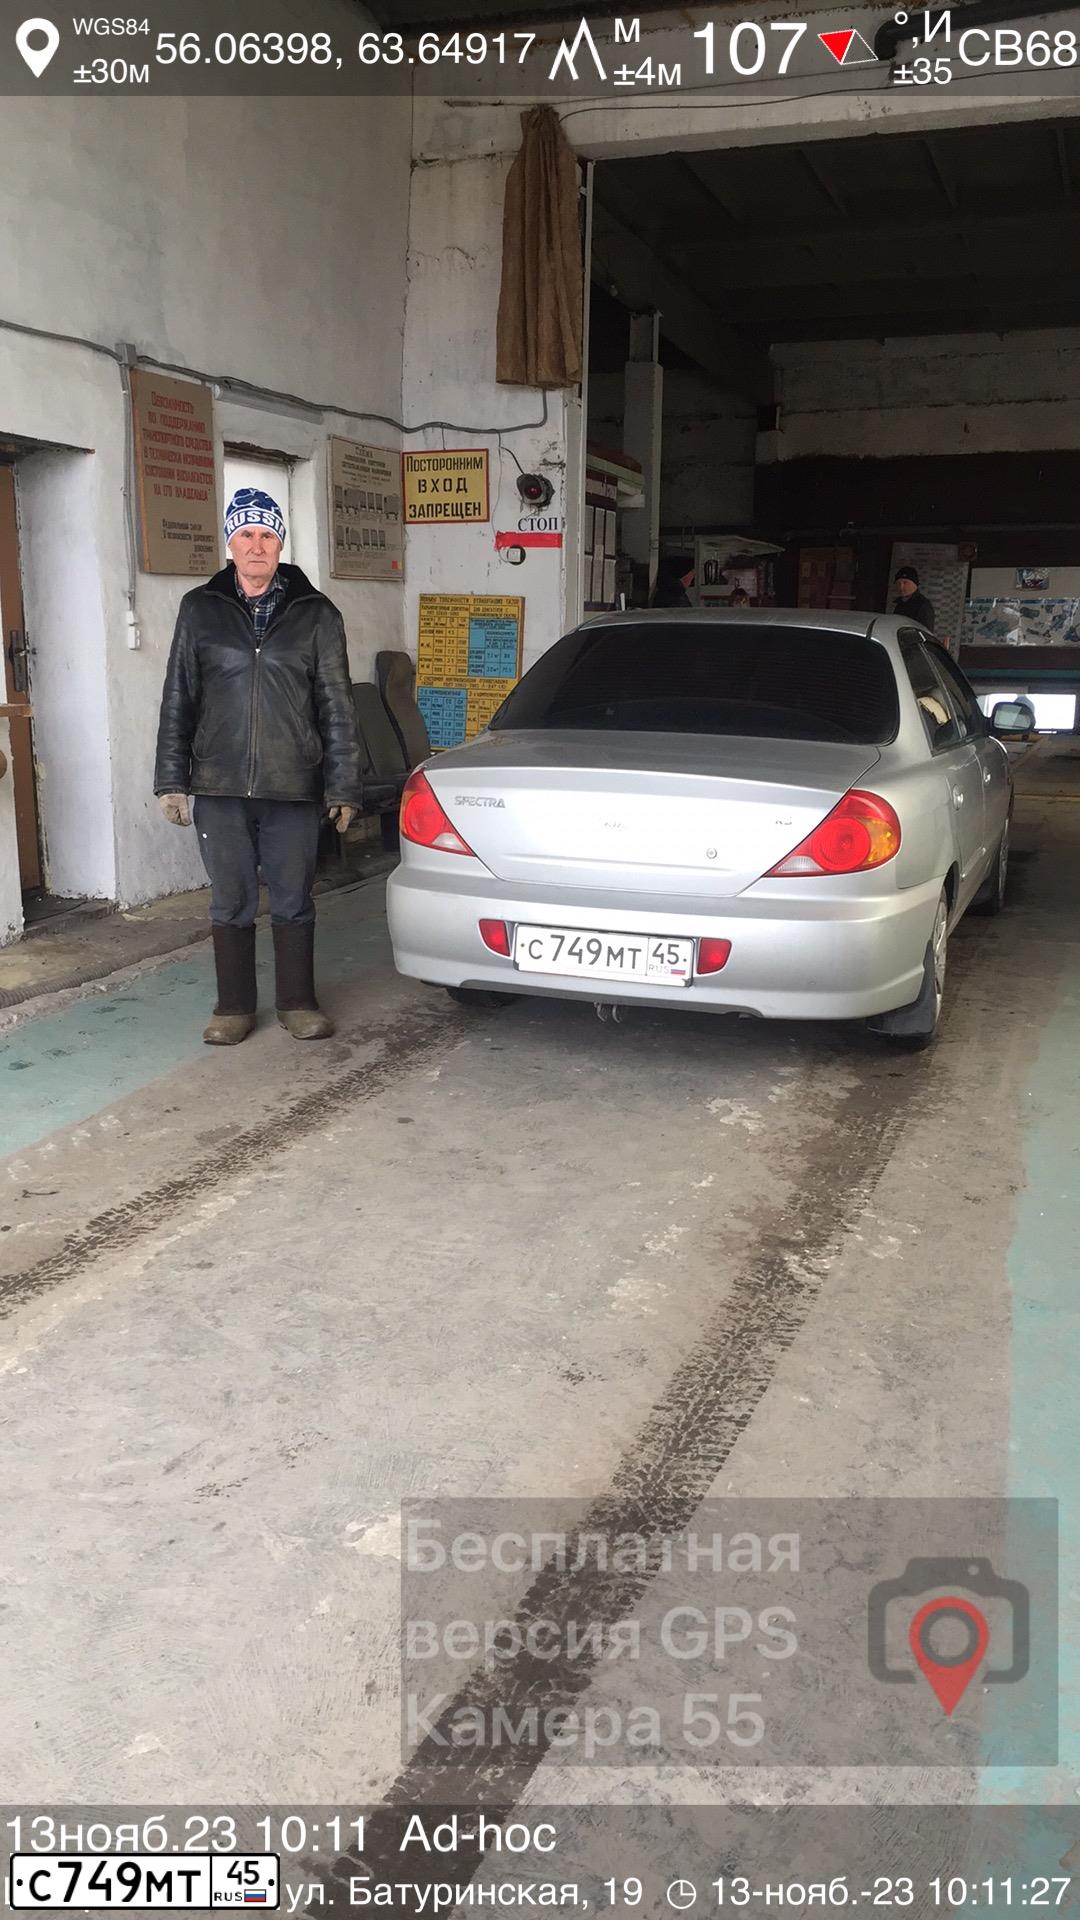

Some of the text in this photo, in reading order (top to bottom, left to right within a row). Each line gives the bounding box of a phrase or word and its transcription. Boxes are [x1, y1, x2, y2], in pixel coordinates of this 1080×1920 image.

[418, 477, 468, 494] ВХОД
[409, 501, 482, 520] ЗАПРЕЩЕН
[518, 516, 559, 533] СТОП
[454, 795, 506, 809] SPECTRA
[652, 942, 680, 966] 45
